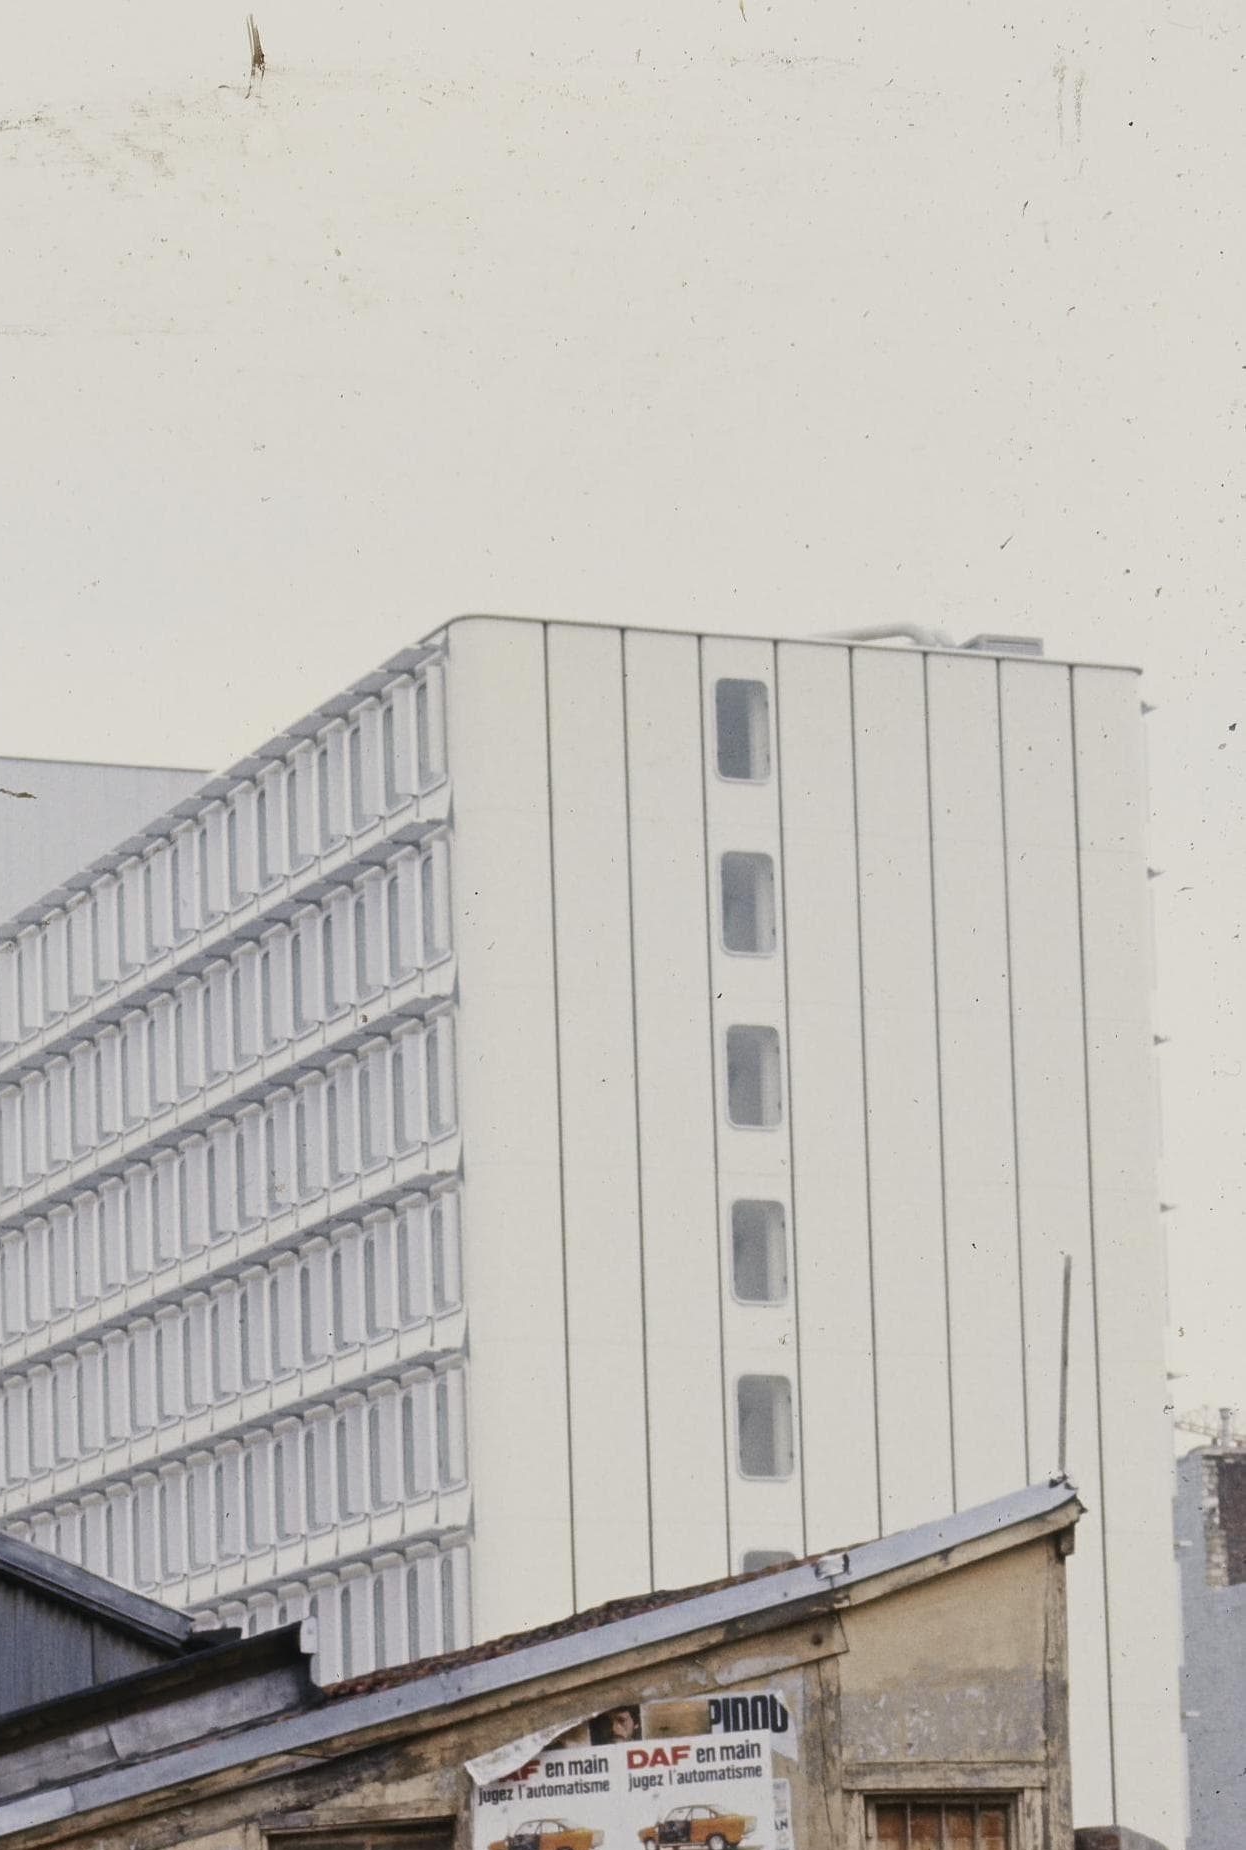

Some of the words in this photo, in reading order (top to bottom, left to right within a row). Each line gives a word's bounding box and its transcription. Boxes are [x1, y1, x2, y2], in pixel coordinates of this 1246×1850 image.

[627, 1745, 691, 1769] DAF
[696, 1746, 716, 1763] en
[720, 1739, 761, 1760] main
[544, 1761, 565, 1778] en
[568, 1755, 609, 1776] main
[627, 1773, 664, 1792] jugez
[478, 1786, 513, 1806] jugez
